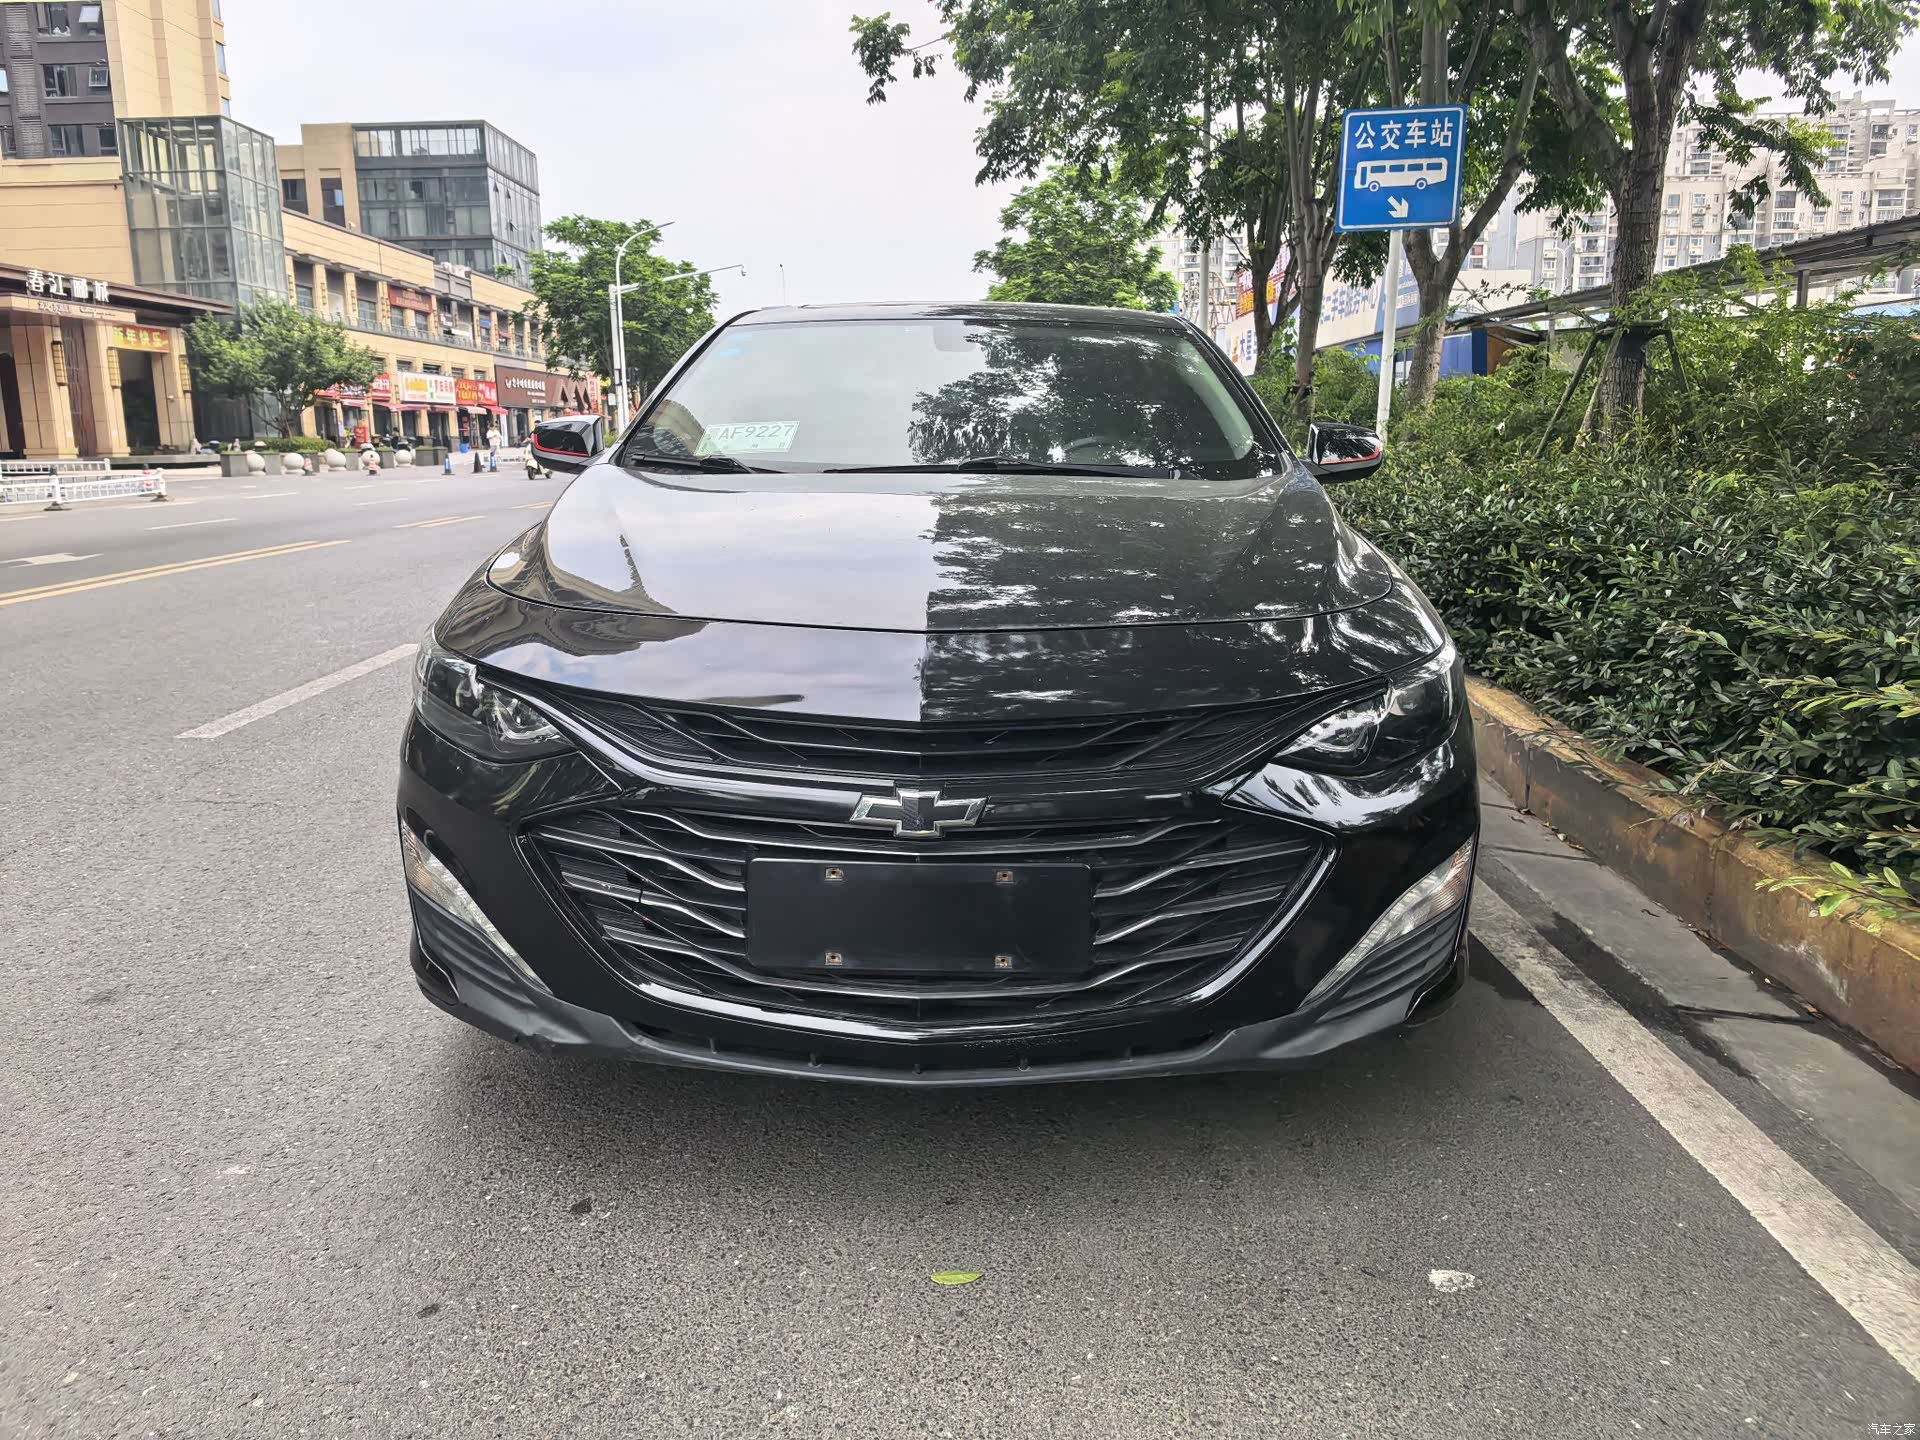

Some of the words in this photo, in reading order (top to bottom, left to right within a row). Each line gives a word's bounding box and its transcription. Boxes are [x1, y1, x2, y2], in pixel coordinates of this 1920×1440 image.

[1355, 116, 1454, 151] 公交车站
[25, 269, 110, 303] 春江郦城
[707, 424, 795, 441] AF9227
